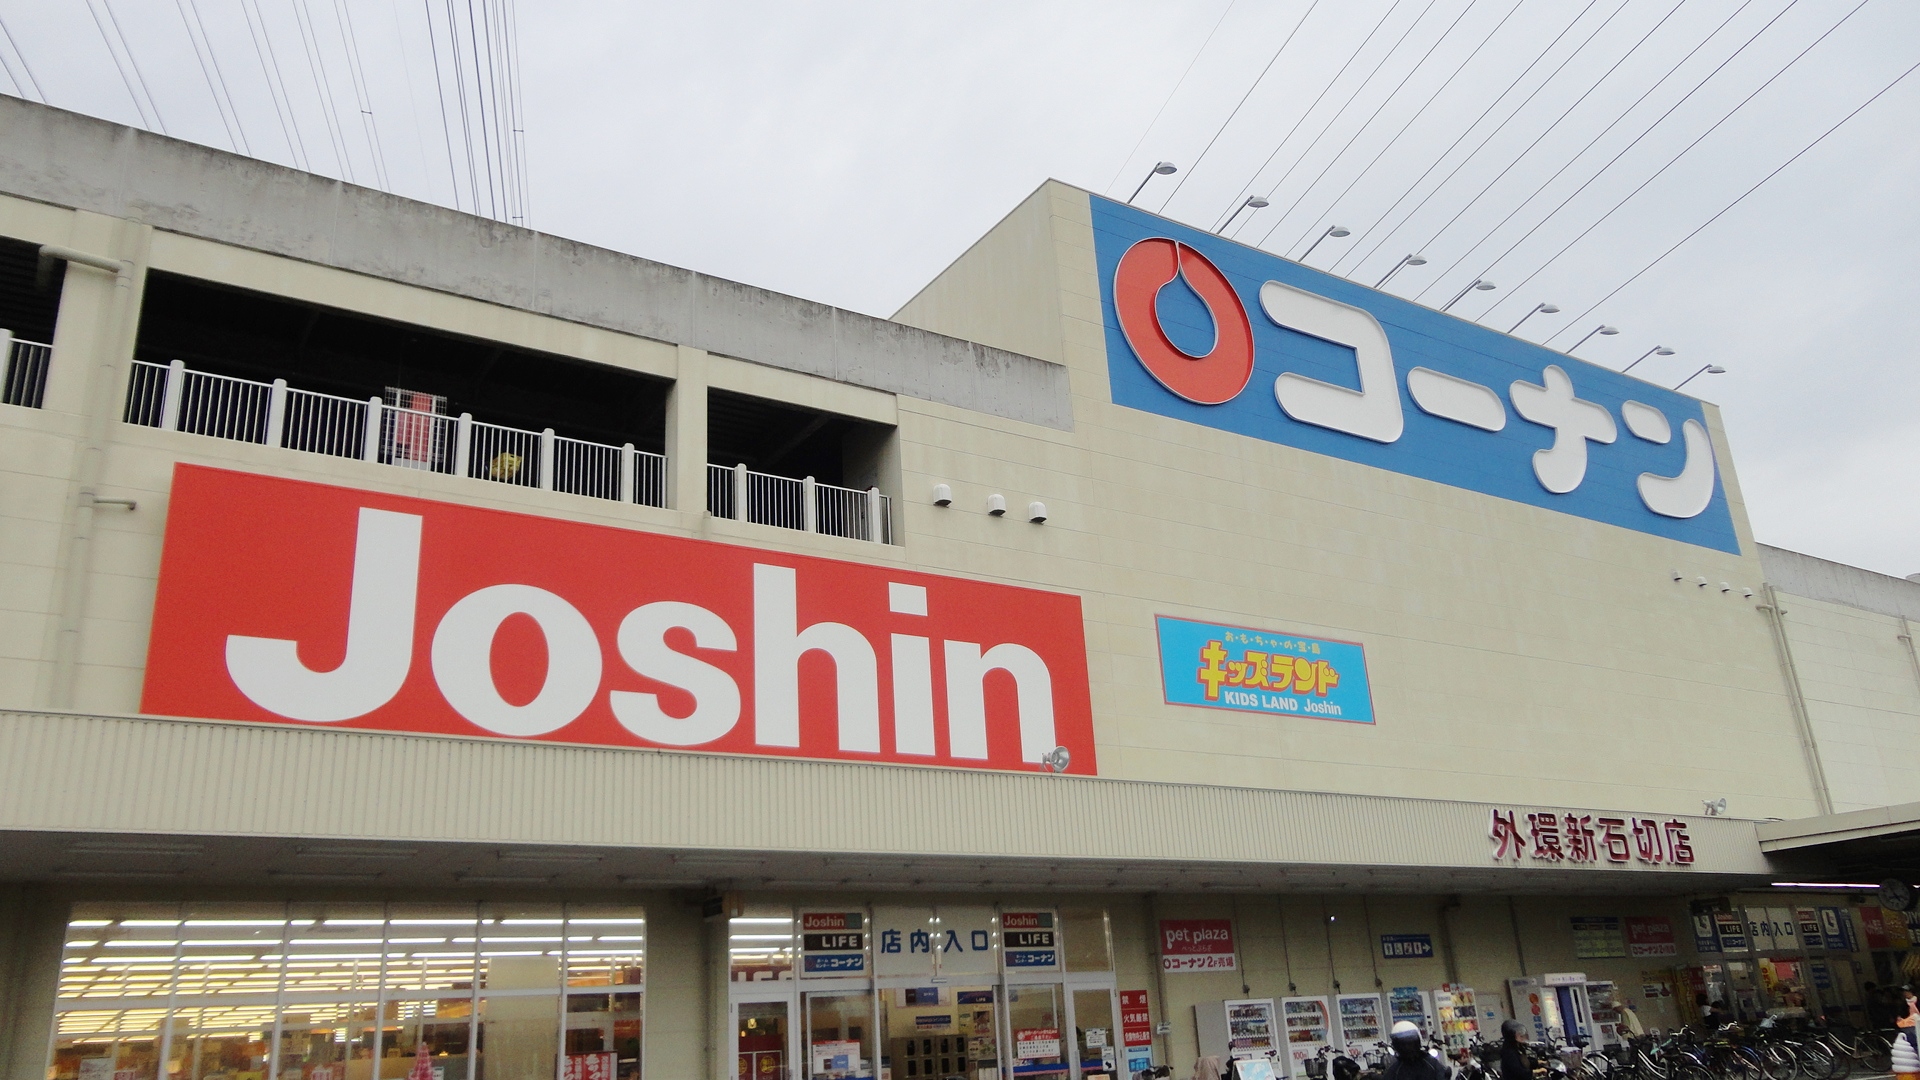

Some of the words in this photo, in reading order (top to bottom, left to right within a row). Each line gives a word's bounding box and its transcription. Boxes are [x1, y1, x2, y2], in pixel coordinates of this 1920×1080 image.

[1259, 280, 1714, 518] コーナン
[225, 506, 1056, 764] Joshin
[1197, 640, 1339, 701] キッズランド
[1224, 691, 1258, 706] KIDS
[1262, 695, 1298, 711] LAND
[1304, 699, 1341, 715] Joshin
[1490, 808, 1695, 864] 外環新石切店
[805, 916, 844, 927] Joshin
[1005, 915, 1037, 926] Joshin
[822, 936, 857, 948] LIFE
[881, 929, 988, 953] 店内入口
[1019, 934, 1049, 944] LIFE
[1166, 928, 1190, 949] pet
[1193, 928, 1228, 944] plaza
[831, 958, 862, 967] コーナン
[1028, 954, 1054, 962] コーナン
